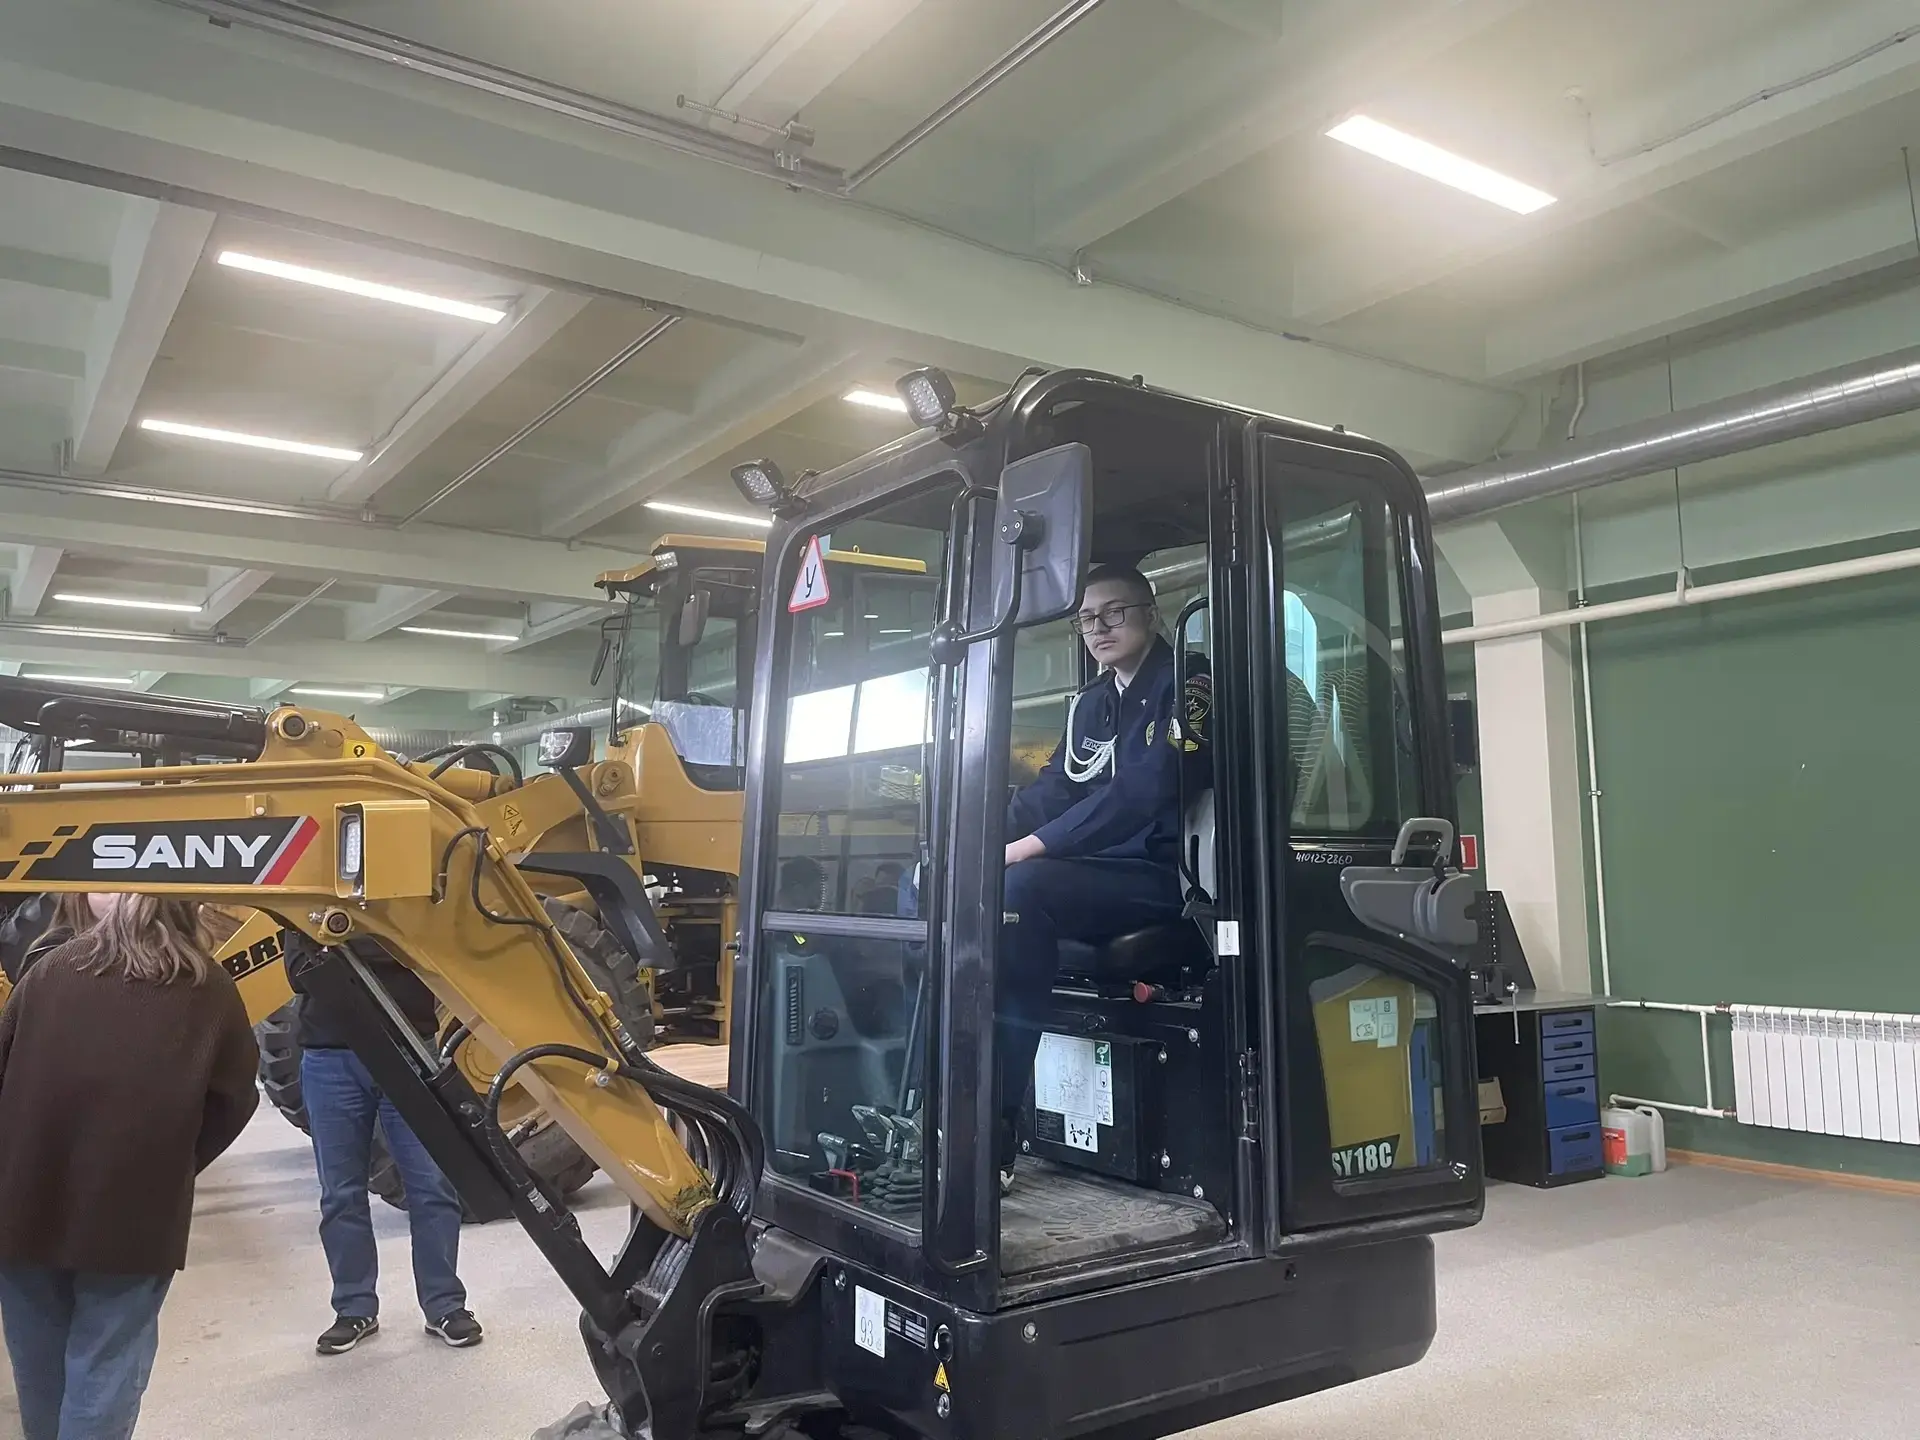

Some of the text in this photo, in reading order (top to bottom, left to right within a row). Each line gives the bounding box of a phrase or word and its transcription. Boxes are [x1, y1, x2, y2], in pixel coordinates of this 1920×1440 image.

[92, 835, 271, 868] SANY
[1331, 1142, 1393, 1176] SY18C
[860, 1316, 874, 1347] 93
